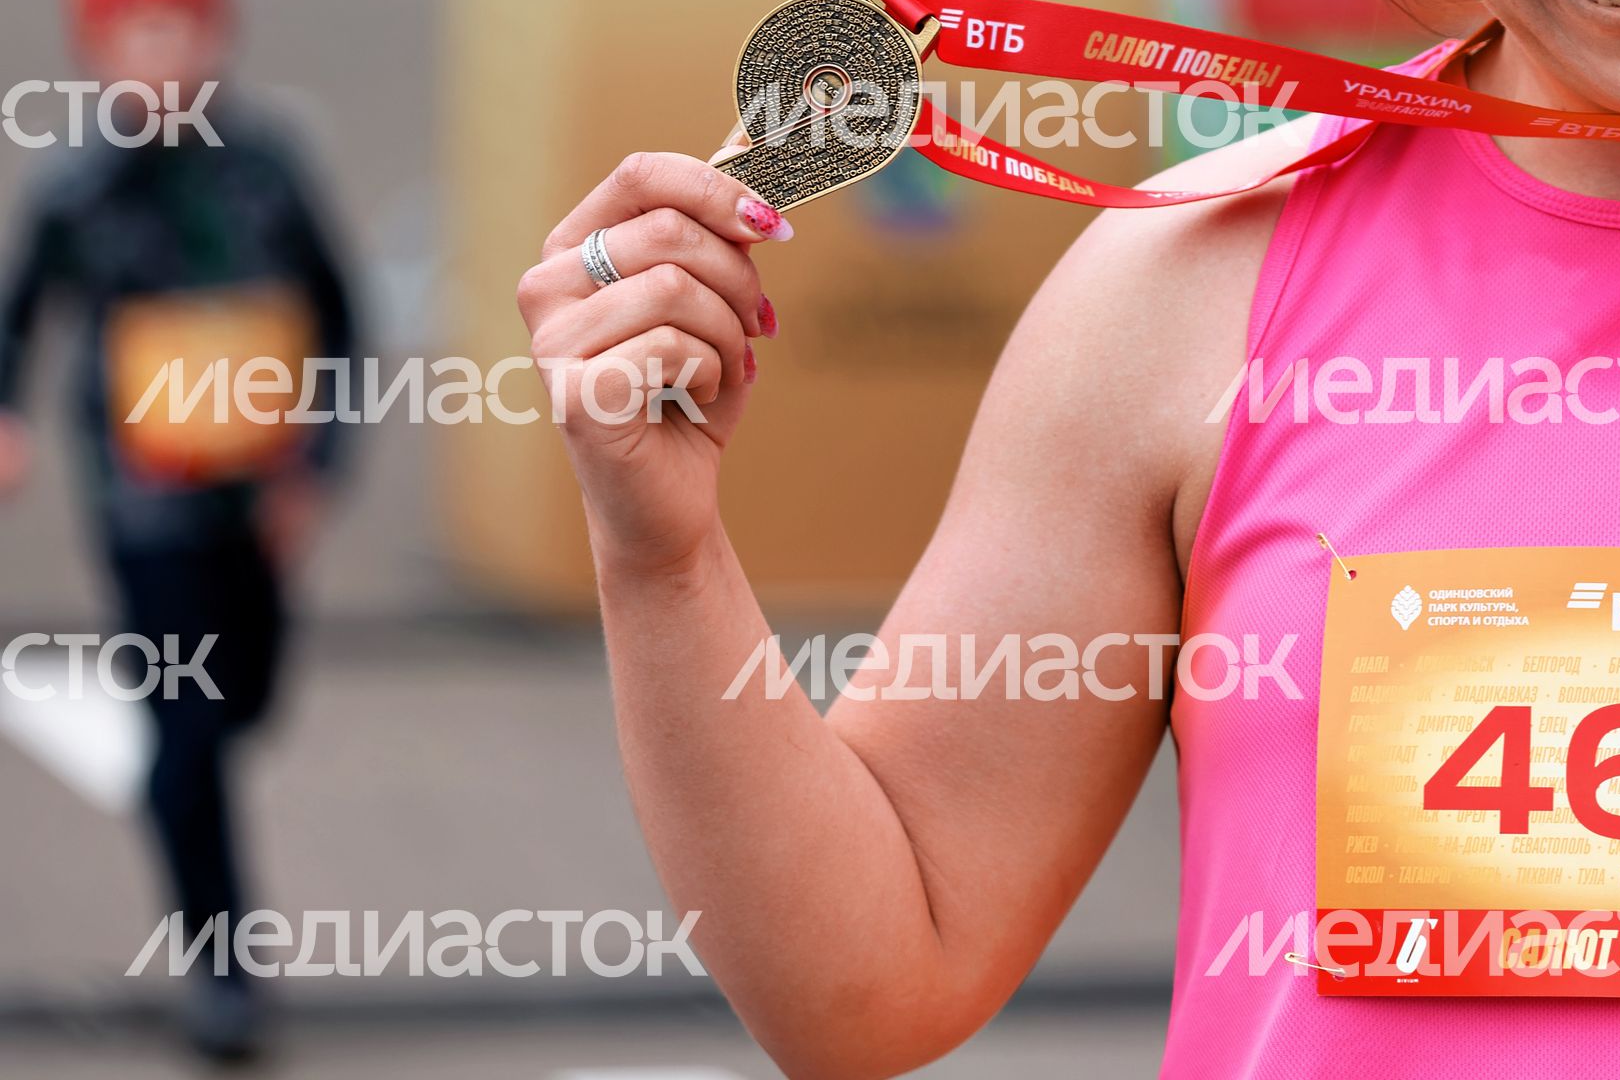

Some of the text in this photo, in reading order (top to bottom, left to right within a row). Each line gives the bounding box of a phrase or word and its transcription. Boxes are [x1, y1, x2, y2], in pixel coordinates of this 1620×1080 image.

[966, 18, 1025, 53] ВТБ
[1083, 30, 1283, 89] САЛЮТ ПОБЕДЫ
[1343, 80, 1472, 114] УРАЛХИМ
[932, 123, 1096, 198] САЛЮТ ПОБЕДЫ
[1429, 587, 1513, 600] ОДИНЦОВСКИЙ
[1428, 602, 1520, 615] ПАРК КУЛЬТУРЫ,
[1428, 615, 1530, 628] СПОРТА И ОТДЫХА
[1350, 655, 1390, 673] АНАПА
[1522, 656, 1582, 675] БЕЛГОРОД
[1453, 685, 1539, 704] ВЛАДИКАВКАЗ
[1416, 715, 1474, 734] ДМИТРОВ
[1539, 716, 1568, 734] ЕЛЕЦ
[1345, 835, 1379, 854] РЖЕВ
[1511, 836, 1592, 856] СЕВАСТОПОЛЬ
[1345, 865, 1386, 884] ОСКОЛ
[1516, 867, 1563, 886] ТИХВИН
[1577, 868, 1606, 886] ТУЛА
[1498, 927, 1619, 971] САЛЮТ
